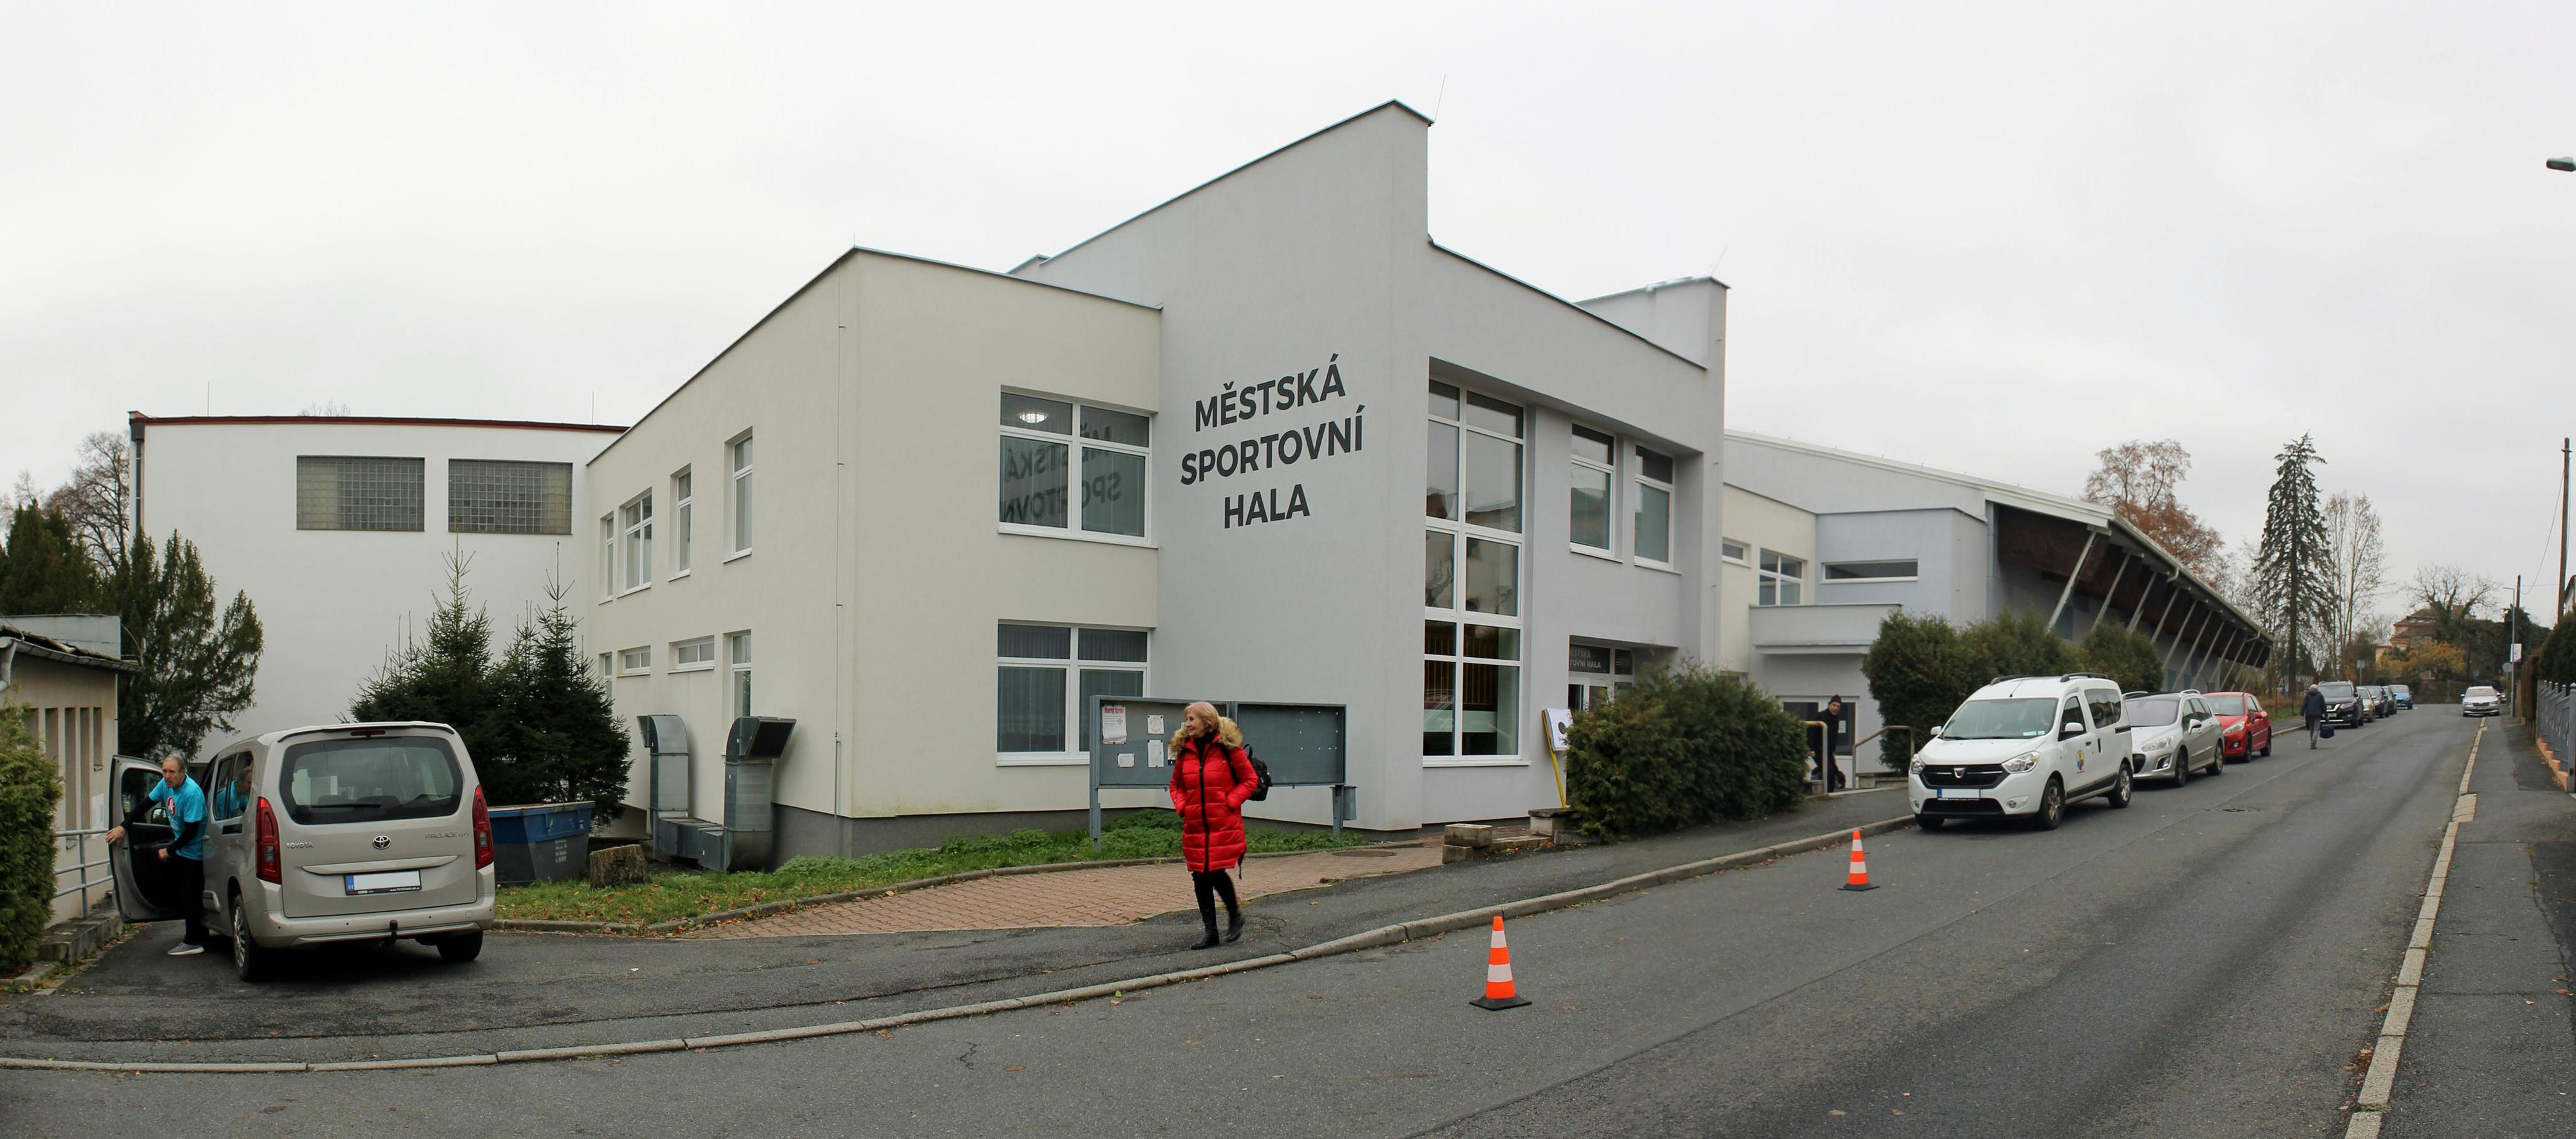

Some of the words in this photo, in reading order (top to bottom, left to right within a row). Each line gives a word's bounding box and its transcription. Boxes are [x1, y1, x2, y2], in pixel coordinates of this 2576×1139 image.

[1195, 353, 1346, 432] MĚSTSKÁ
[1180, 404, 1365, 485] SPORTOVNÍ
[1224, 483, 1311, 529] HALA
[1586, 660, 1602, 669] HALA
